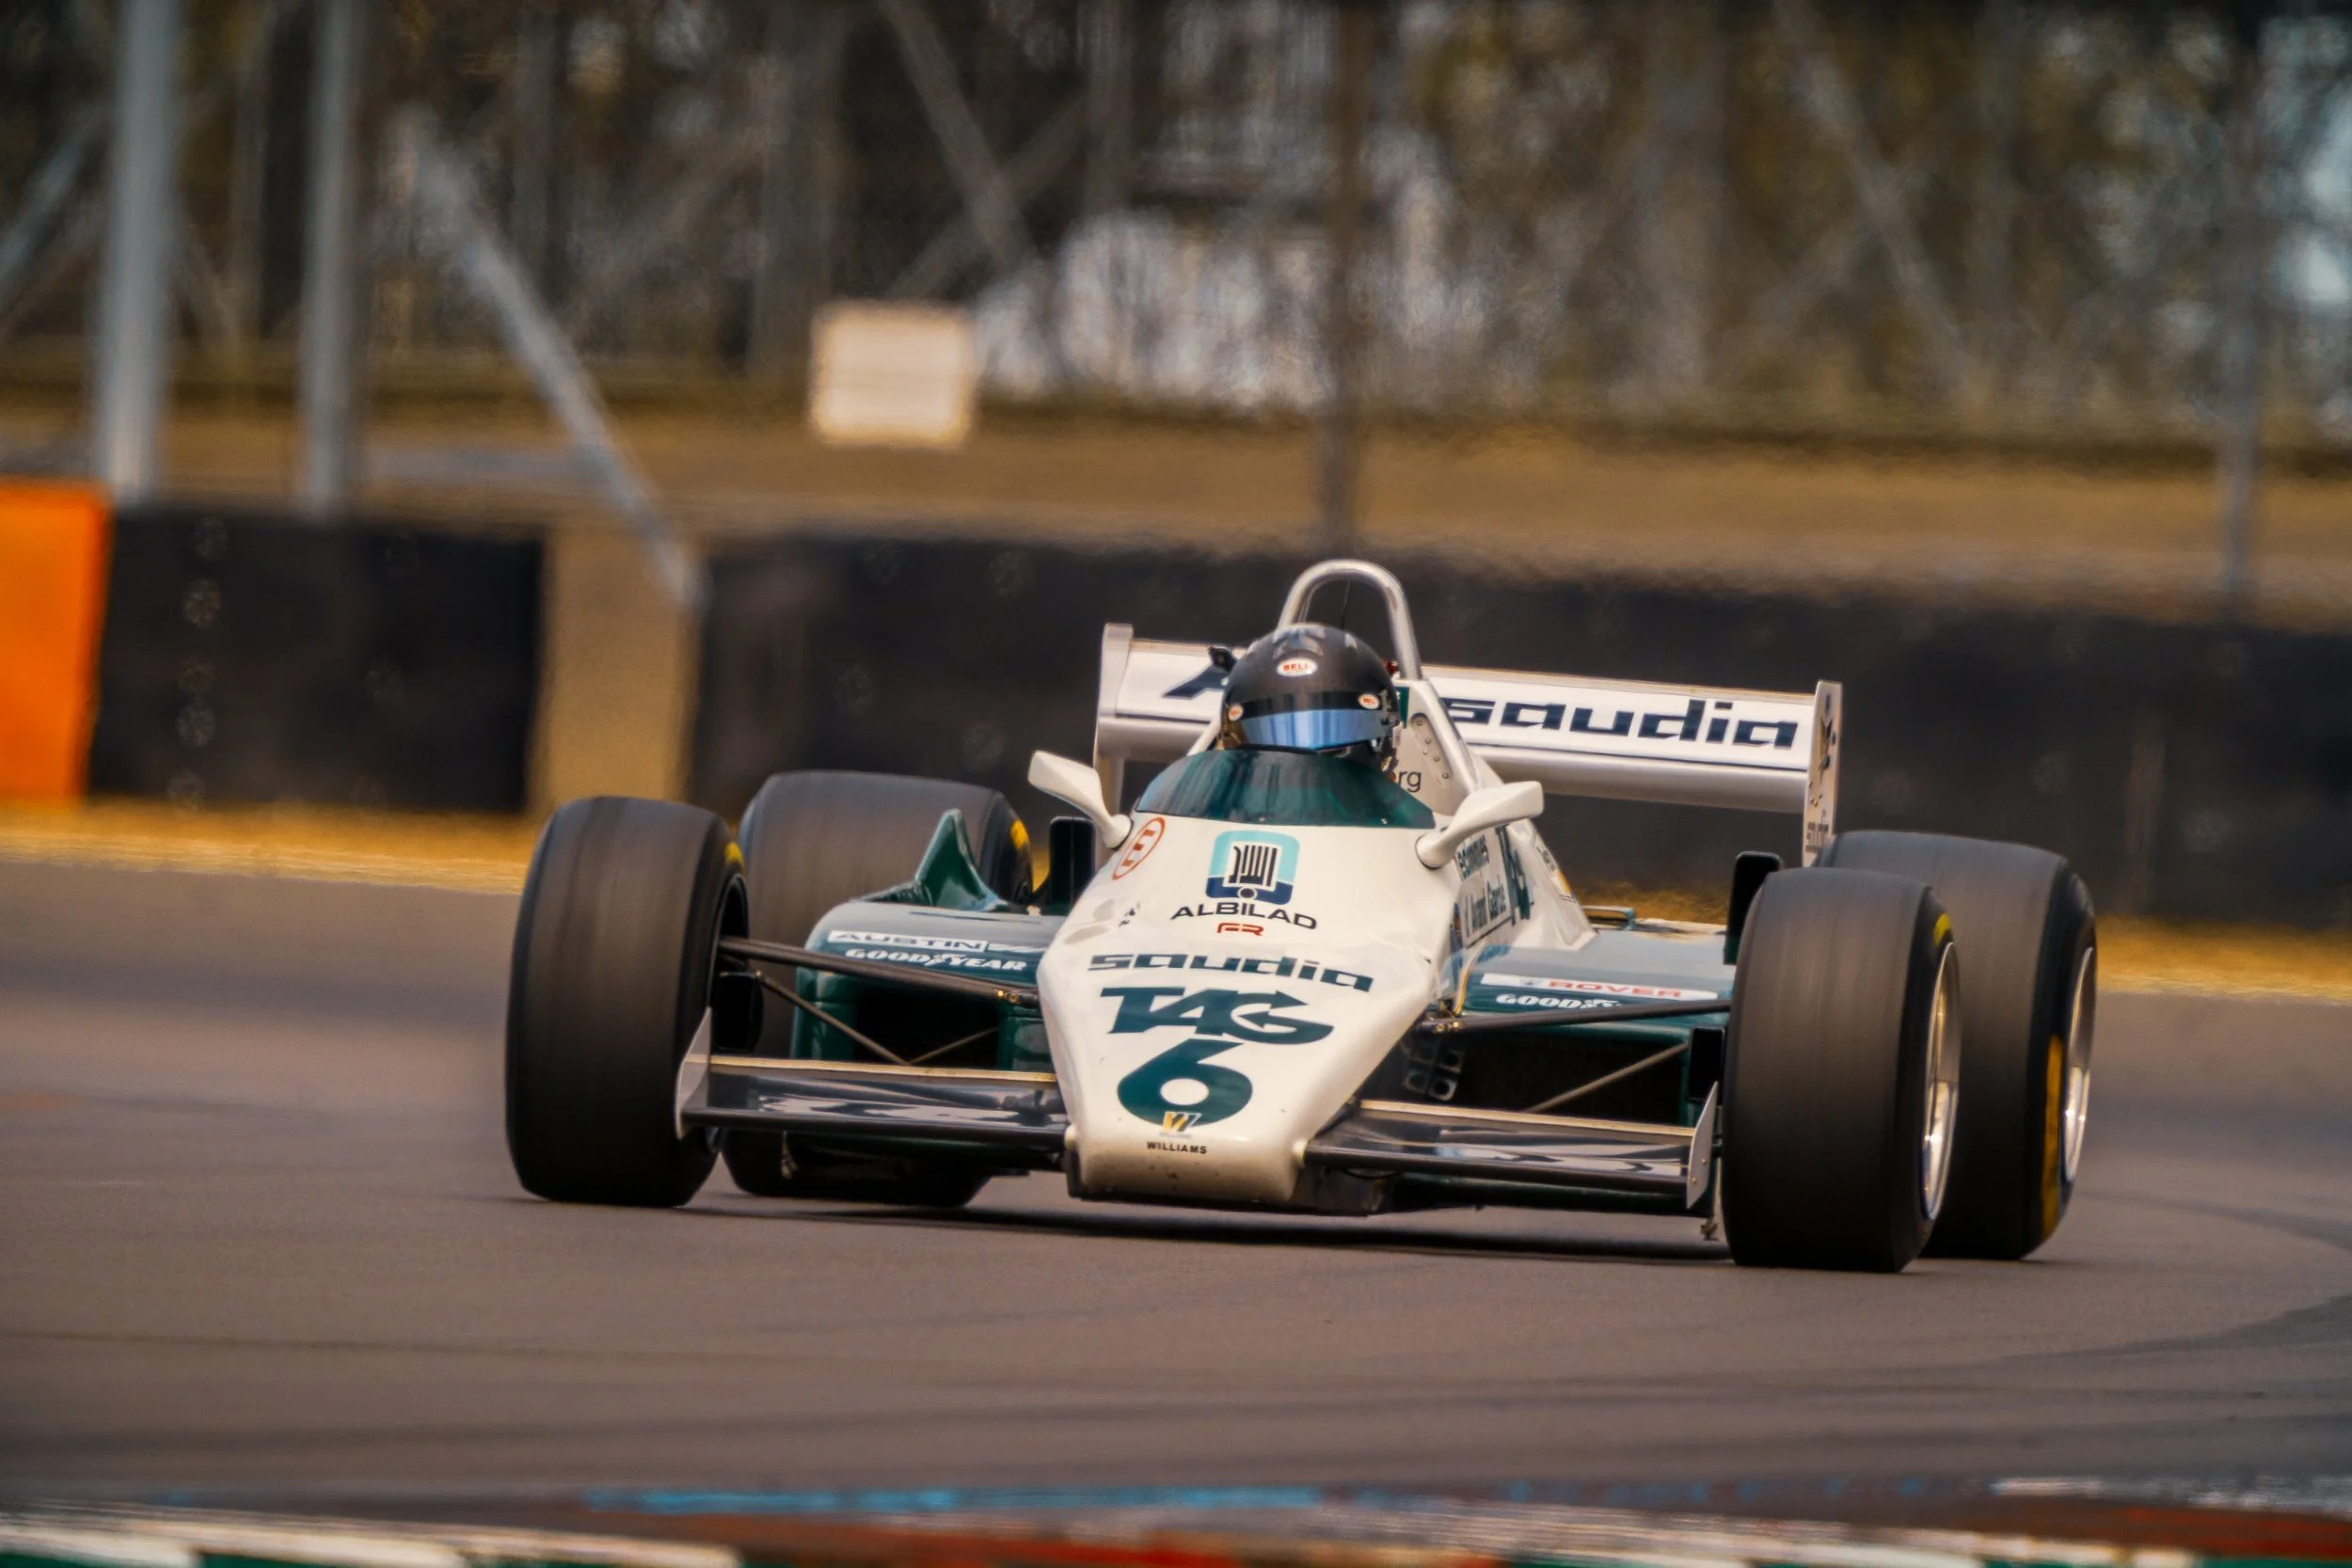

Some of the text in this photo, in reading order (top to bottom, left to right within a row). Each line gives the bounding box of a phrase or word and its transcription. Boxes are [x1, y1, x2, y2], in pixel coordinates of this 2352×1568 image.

[1438, 697, 1799, 751] saudia
[1169, 901, 1318, 930] ALBILAD
[834, 932, 980, 950] AUSTIN
[845, 948, 1027, 971] GOODYEAR
[1088, 953, 1375, 992] saudia
[1548, 979, 1682, 999] ROVER
[1117, 1037, 1253, 1127] 6
[1146, 1141, 1208, 1155] WILLIAMS
